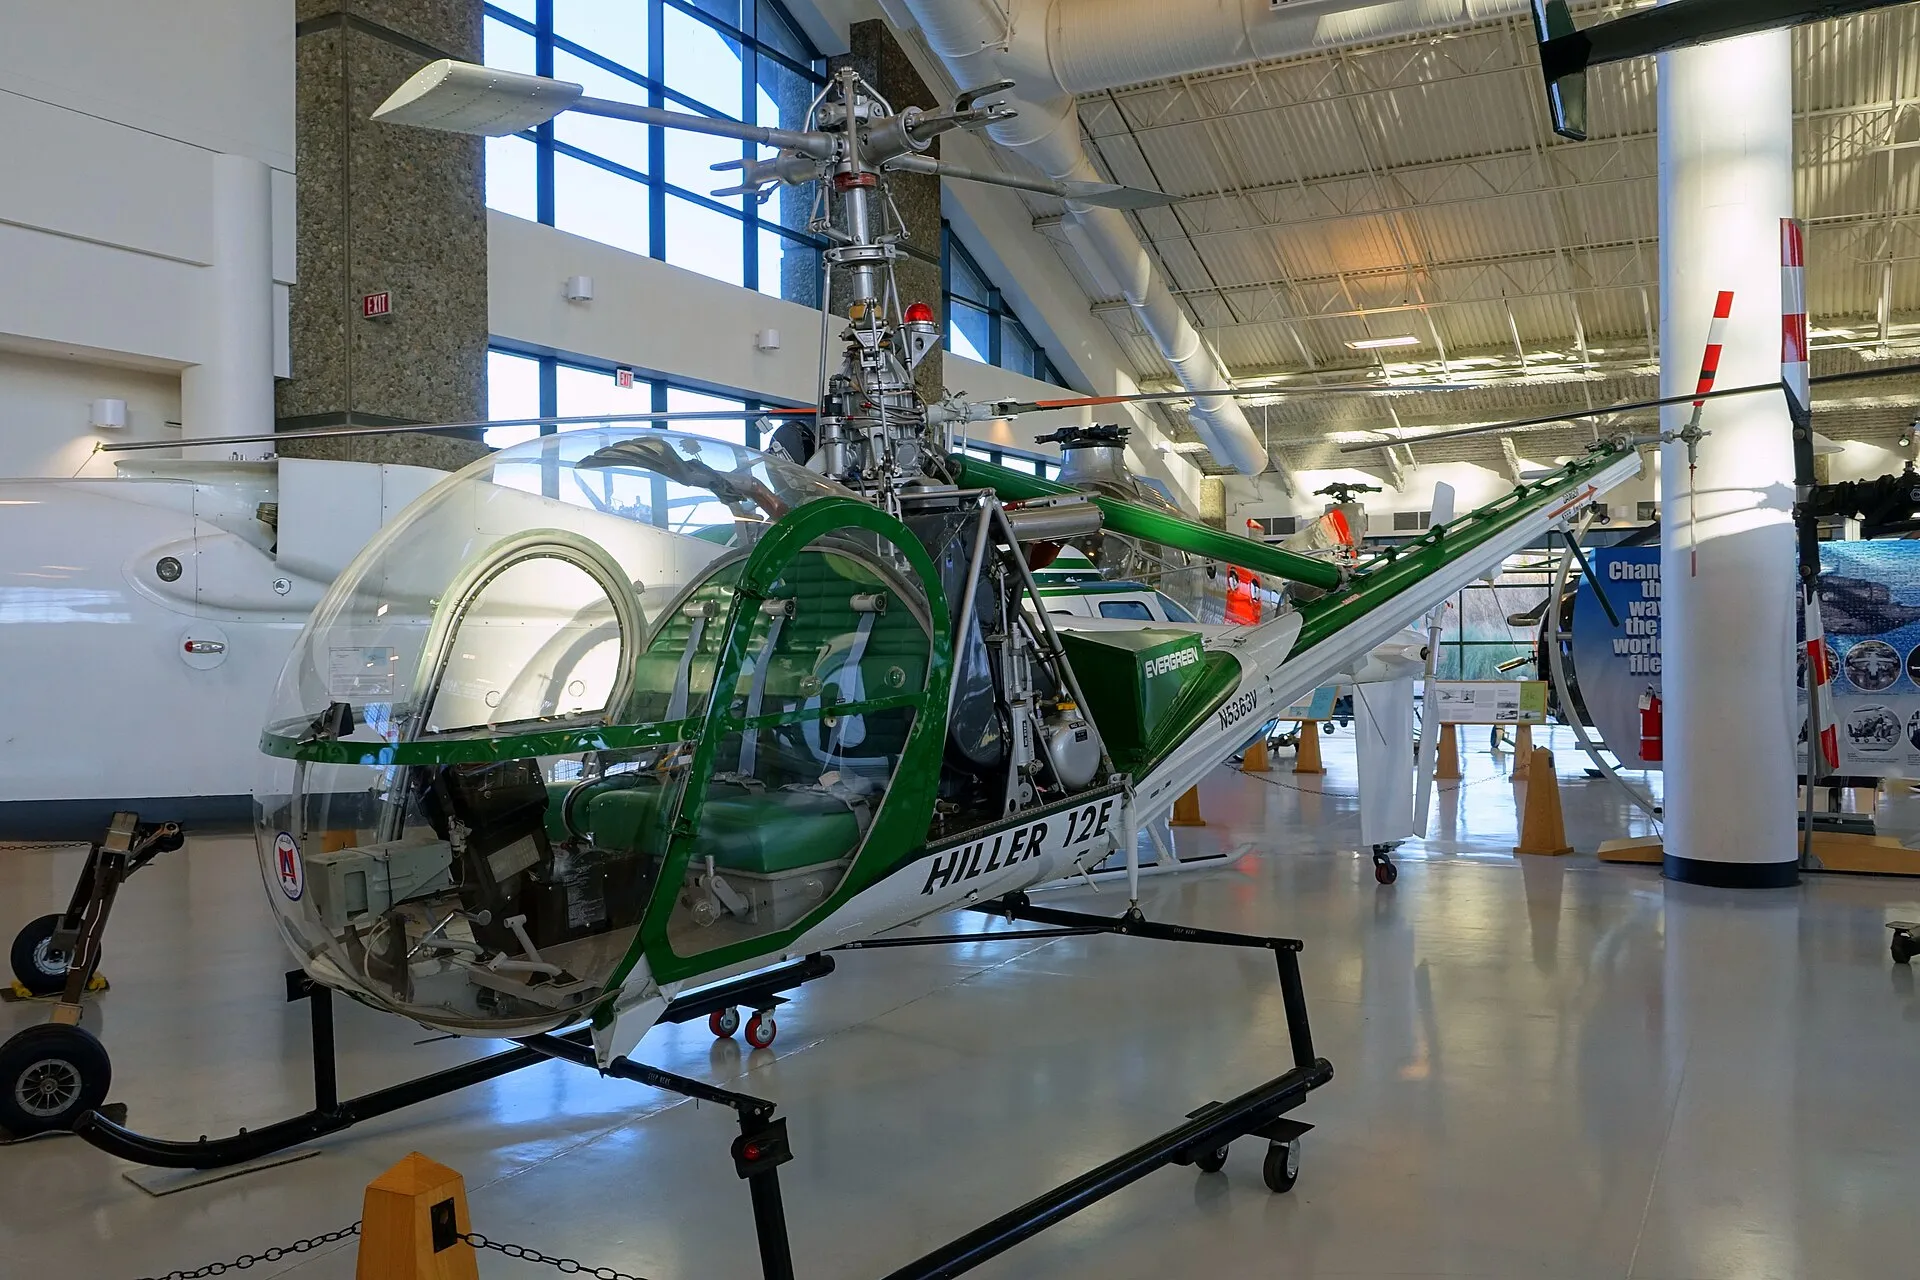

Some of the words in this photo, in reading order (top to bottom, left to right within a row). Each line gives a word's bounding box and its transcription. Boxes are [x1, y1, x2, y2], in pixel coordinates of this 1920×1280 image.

[367, 294, 386, 315] EXIT
[620, 371, 632, 387] EXIT
[1609, 561, 1661, 580] Chan
[1641, 580, 1661, 598] th
[1625, 617, 1657, 635] the
[1144, 646, 1199, 679] EVERGREEN
[1629, 655, 1661, 673] flie
[1218, 689, 1257, 731] N5363V
[921, 822, 1048, 895] HILLER
[1063, 800, 1113, 848] 12E
